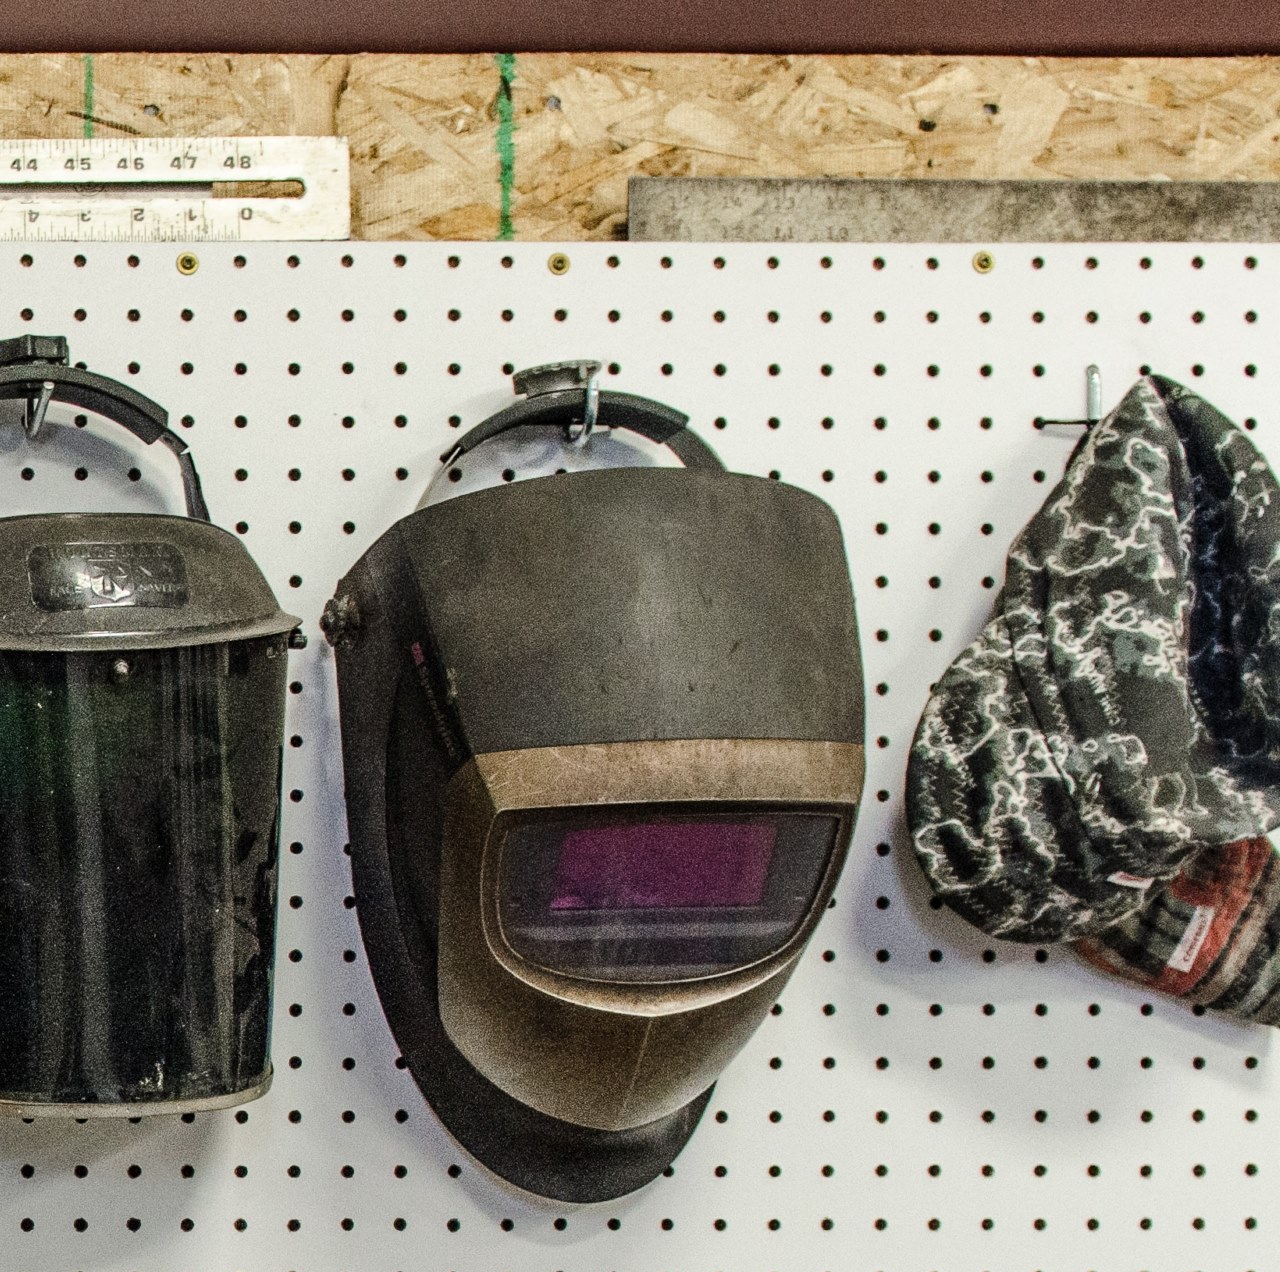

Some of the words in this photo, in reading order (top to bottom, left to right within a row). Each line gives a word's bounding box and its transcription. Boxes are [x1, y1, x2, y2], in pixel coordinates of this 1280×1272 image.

[10, 156, 38, 173] 44
[63, 156, 92, 173] 45
[116, 155, 145, 172] 46
[170, 155, 198, 172] 47
[223, 154, 252, 171] 48
